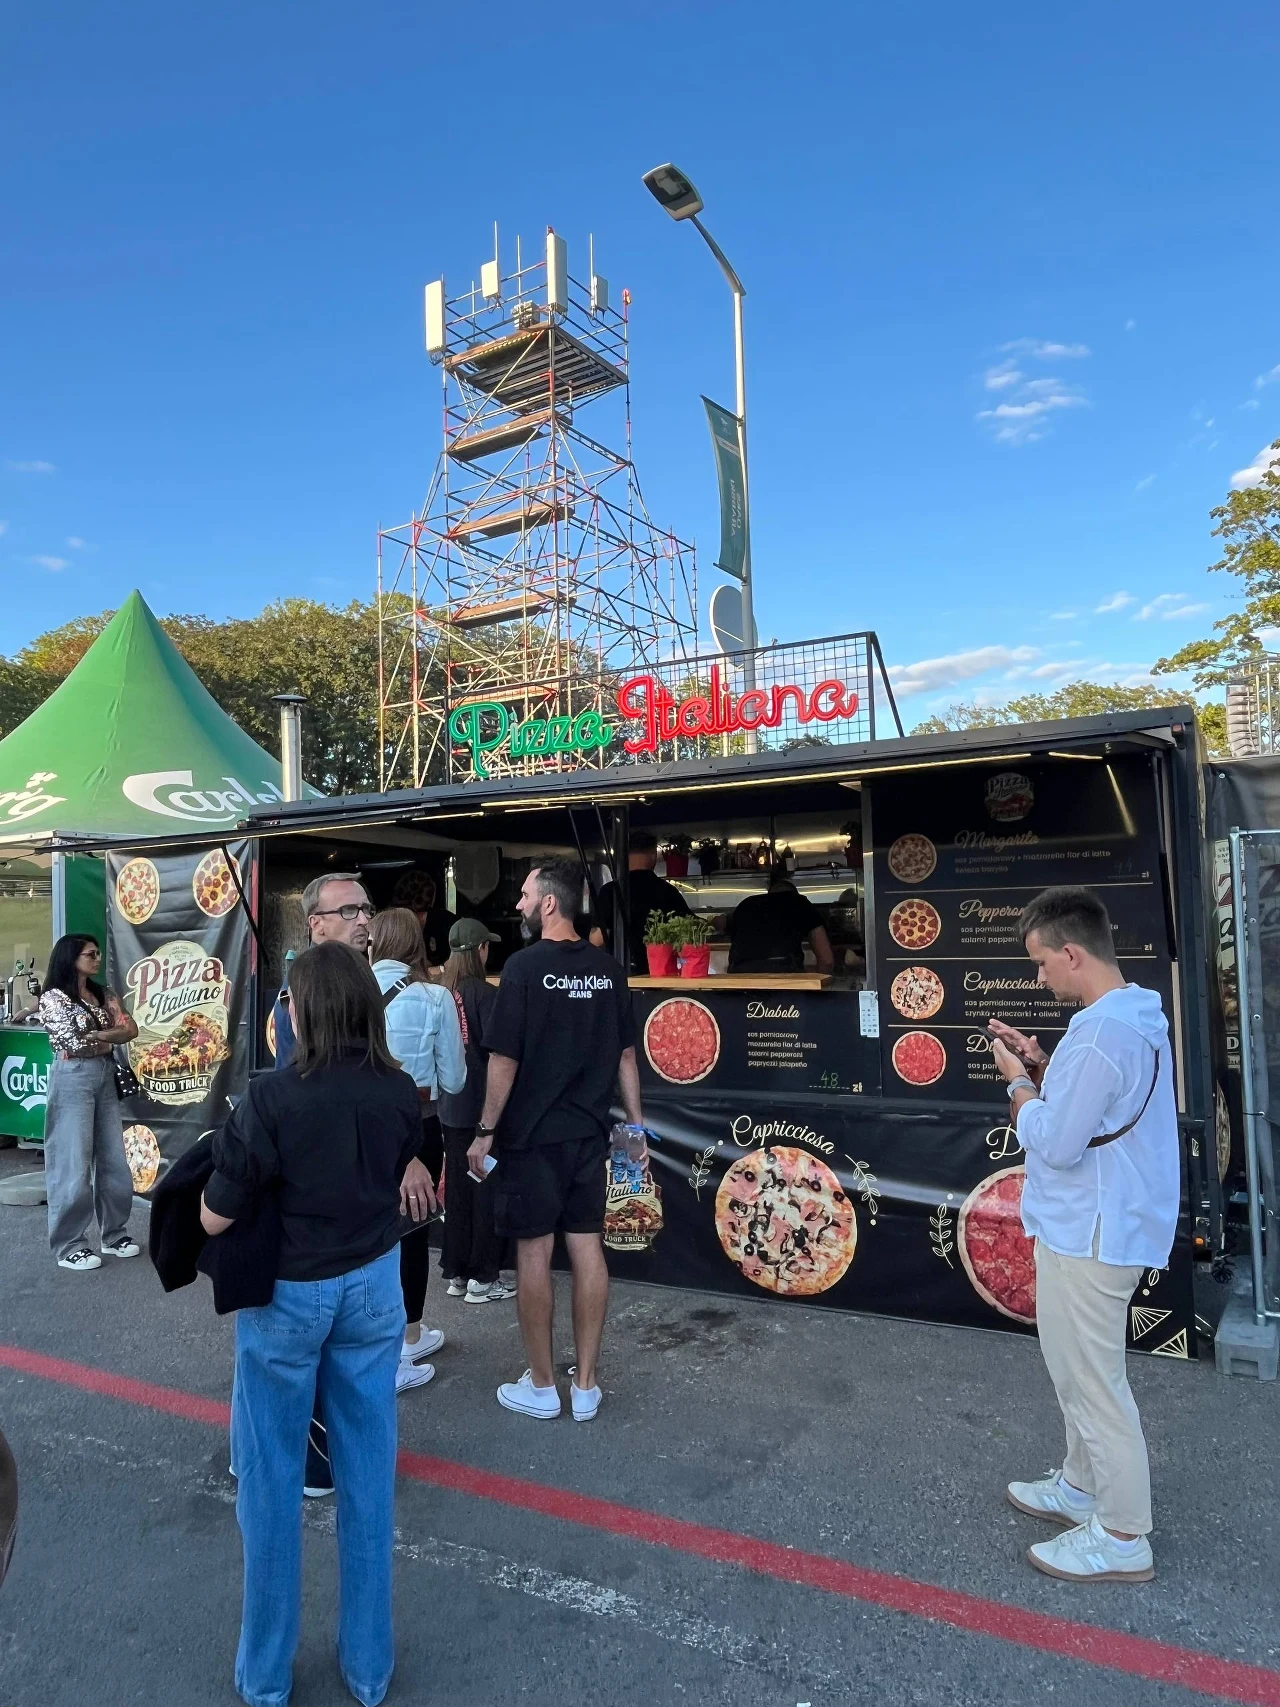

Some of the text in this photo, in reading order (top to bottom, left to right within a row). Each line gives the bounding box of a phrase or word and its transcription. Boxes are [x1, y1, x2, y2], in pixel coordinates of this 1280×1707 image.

[449, 664, 858, 778] Pizza Italiana
[123, 770, 287, 823] Carls
[127, 957, 225, 1011] Pizza
[543, 974, 613, 990] Calvin Klein
[568, 990, 592, 999] JEANS
[144, 985, 224, 1025] Italiano
[746, 1001, 800, 1019] Diabola
[979, 999, 1027, 1008] pomidorowy
[965, 1010, 1061, 1018] szynka pieczarki oliwki
[759, 1031, 799, 1039] pomidorowy
[770, 1051, 804, 1059] pepperoni
[1, 1055, 51, 1101] Carls
[149, 1076, 209, 1093] FOOD TRUCK
[821, 1070, 839, 1086] 48
[730, 1115, 835, 1155] Capricciosa
[606, 1183, 653, 1198] Italino
